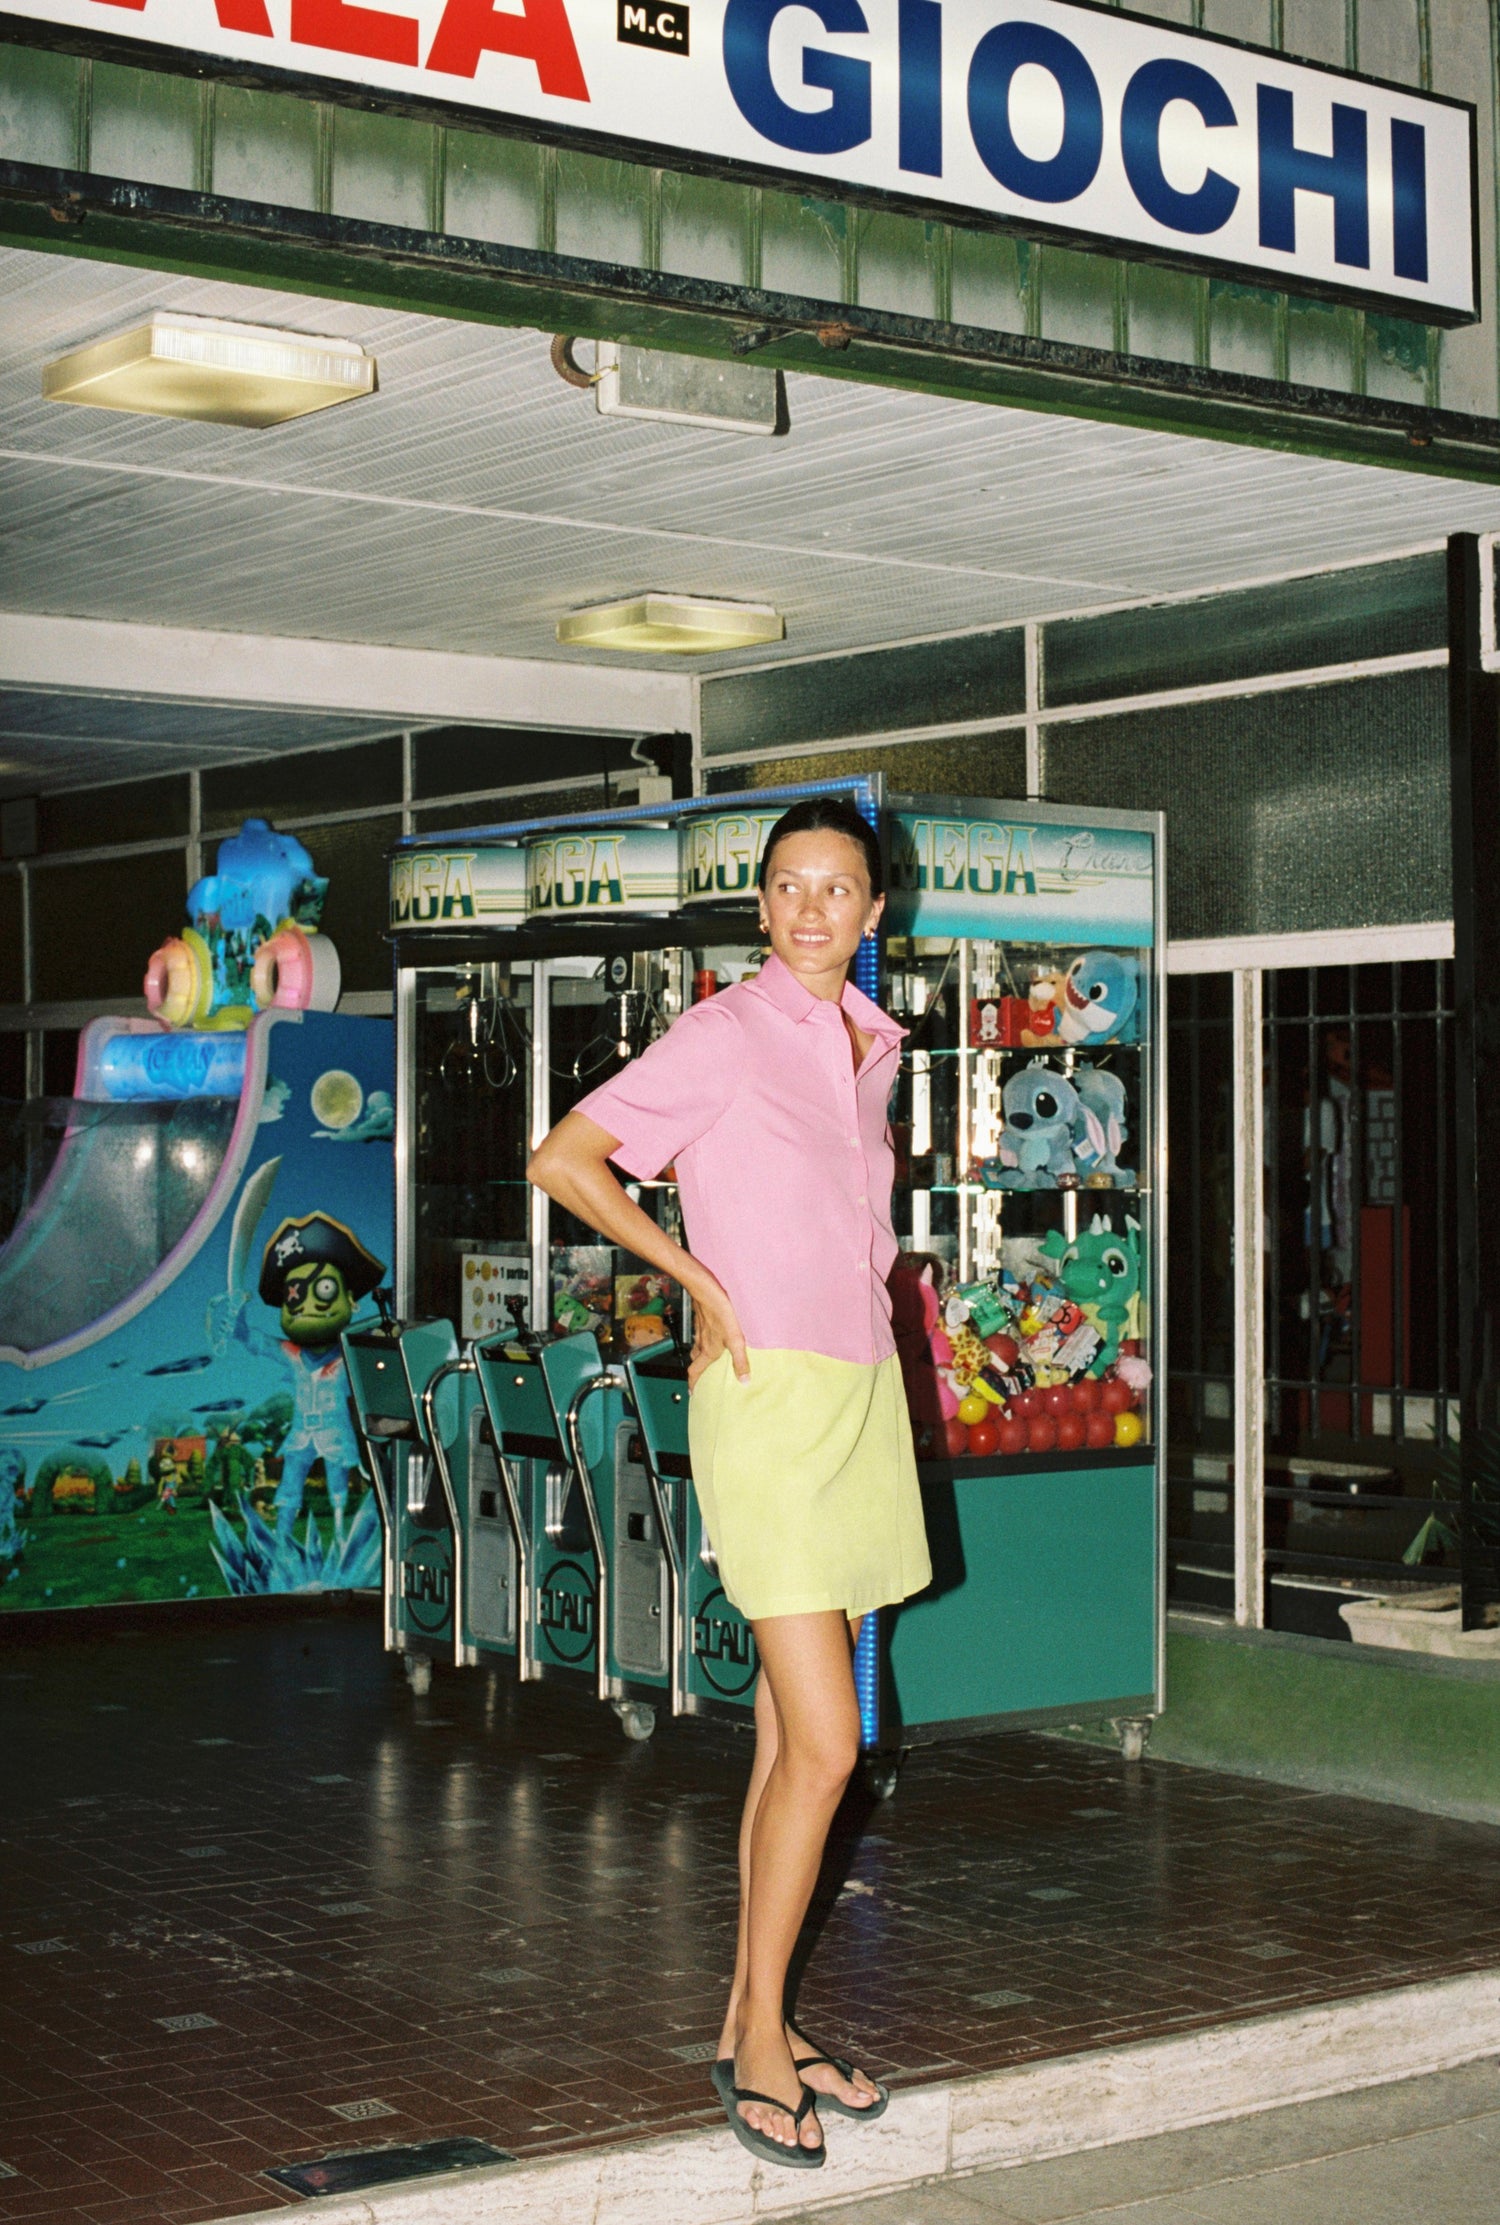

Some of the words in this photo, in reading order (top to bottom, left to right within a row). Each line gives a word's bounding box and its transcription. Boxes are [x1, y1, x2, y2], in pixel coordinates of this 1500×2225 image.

[623, 4, 683, 41] M.C.
[723, 0, 1429, 283] GIOCHI
[890, 819, 1038, 897] MEGA
